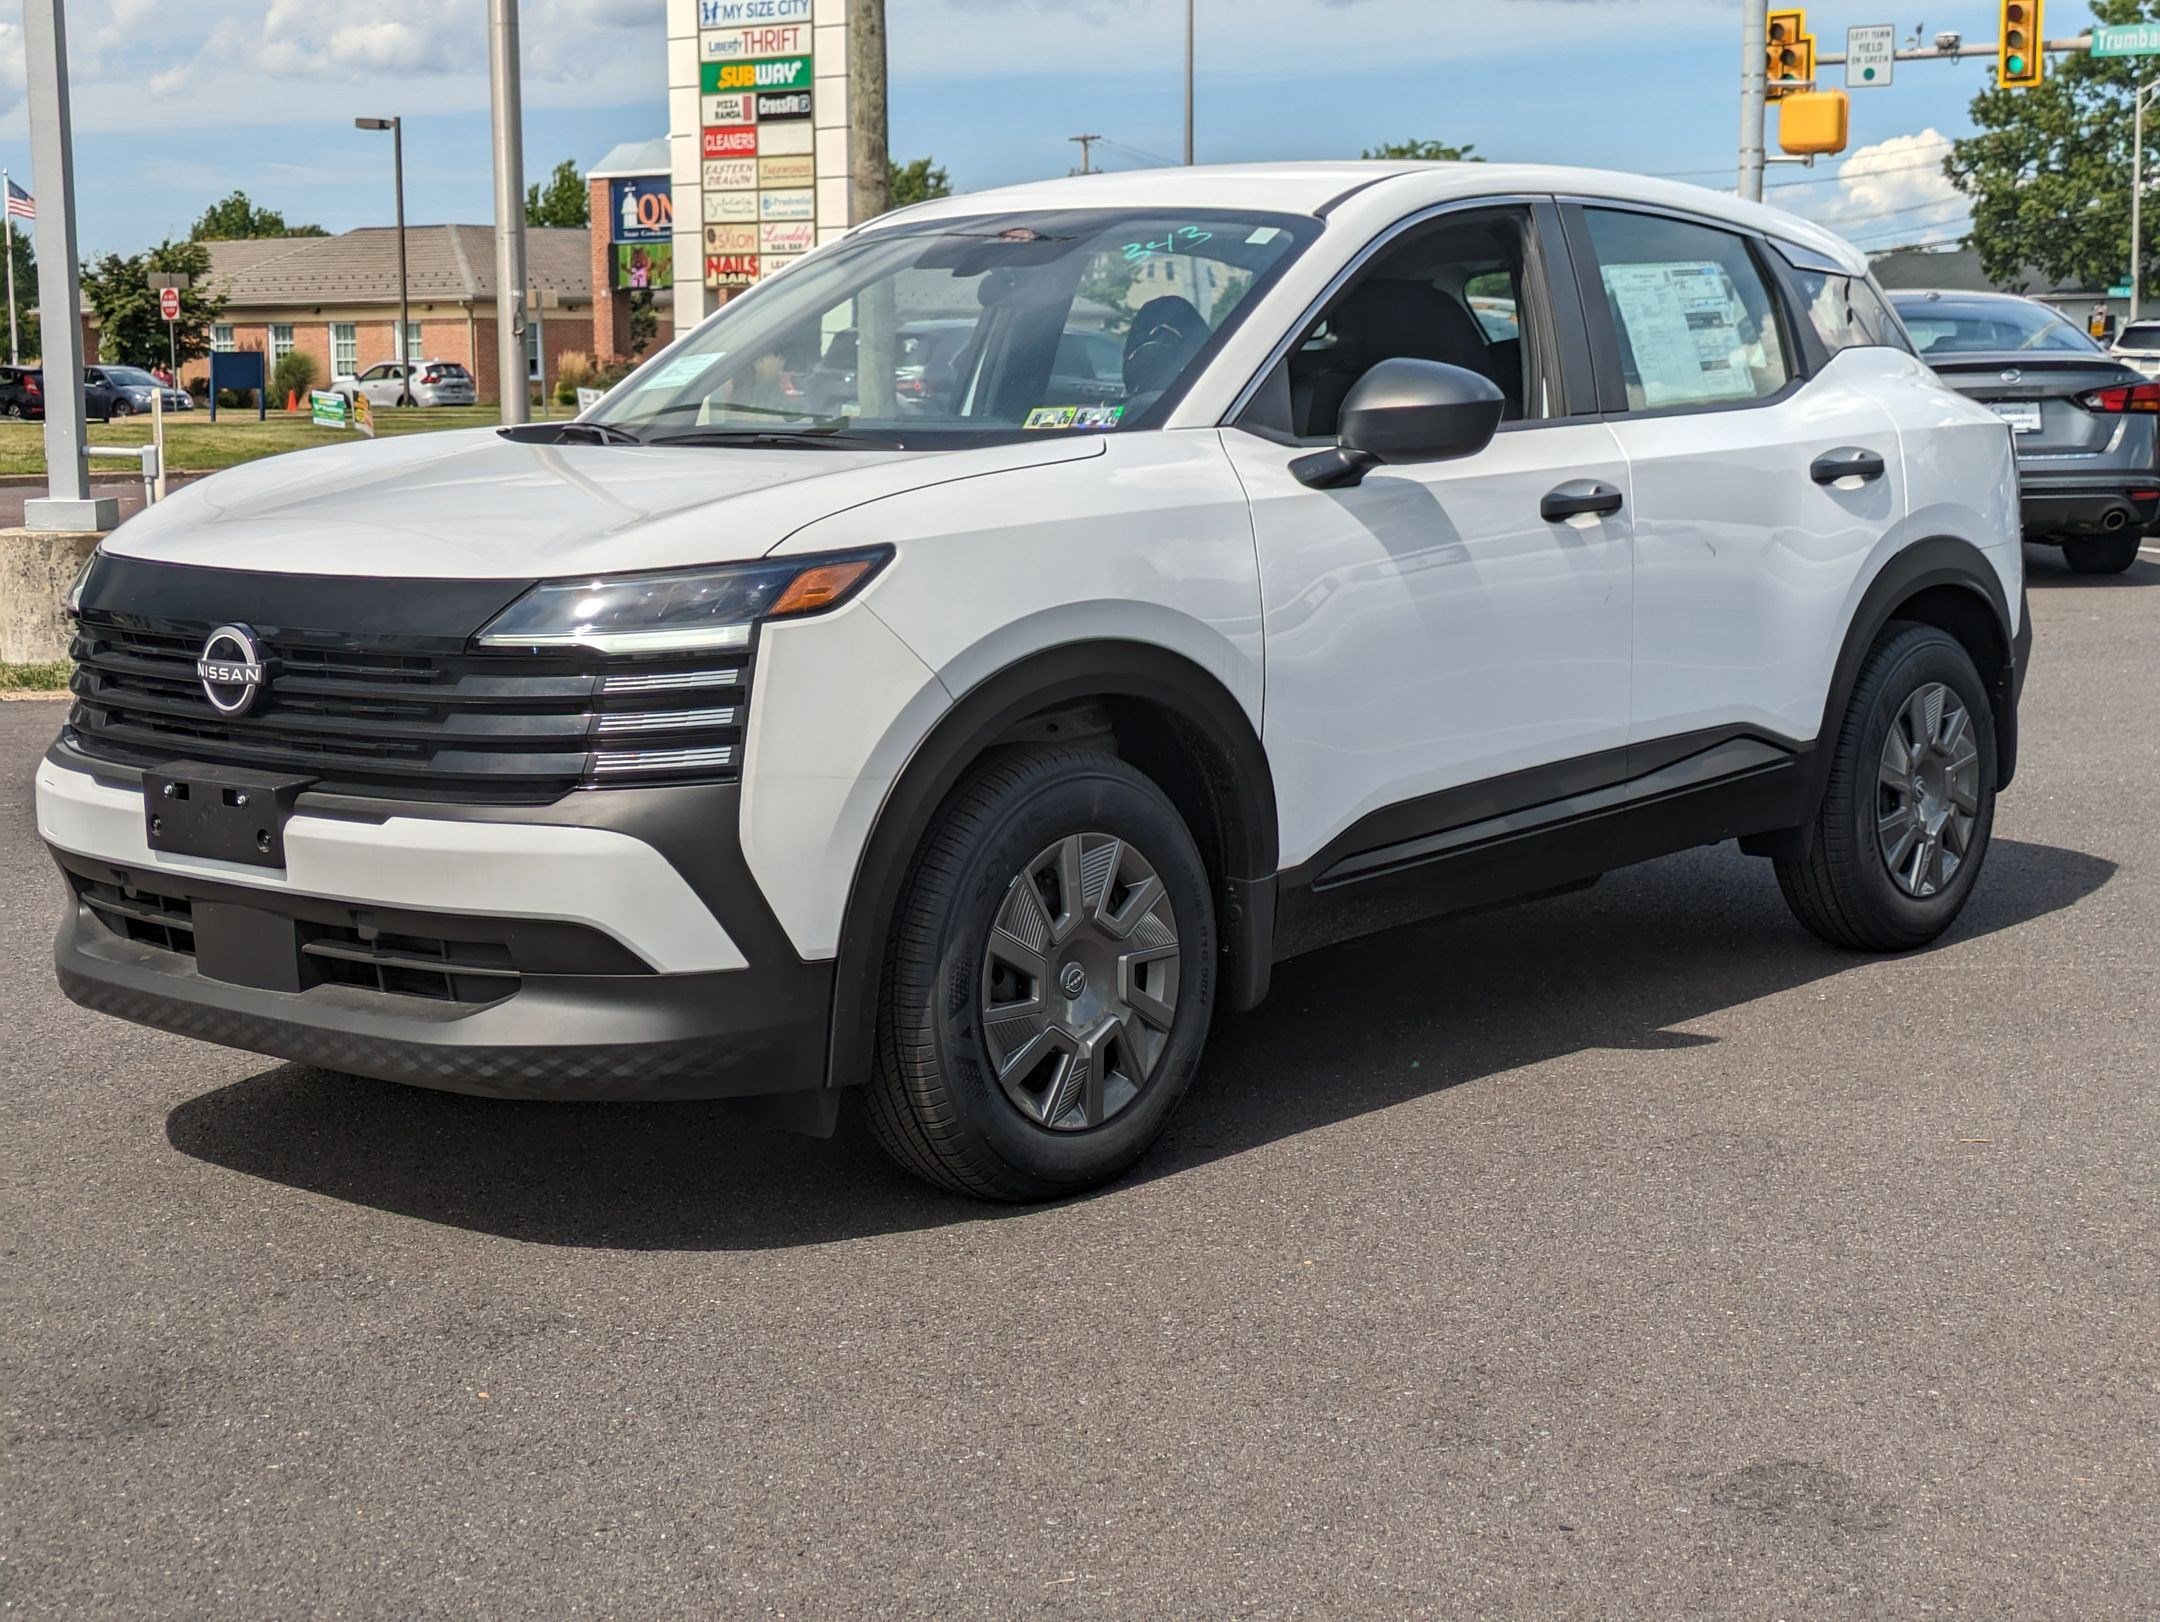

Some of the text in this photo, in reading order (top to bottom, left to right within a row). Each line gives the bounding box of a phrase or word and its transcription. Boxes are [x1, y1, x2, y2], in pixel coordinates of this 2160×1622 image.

[722, 0, 808, 19] MY SIZE CITY
[742, 27, 799, 54] THRIFT
[1851, 31, 1890, 41] LEFT TURN
[1858, 42, 1883, 53] YIELD
[1851, 55, 1888, 64] ON GREEN
[717, 61, 801, 89] SUBWAY
[716, 100, 738, 109] PIZZA
[758, 95, 798, 115] CrossFit
[704, 132, 755, 150] CLEANERS
[705, 164, 753, 175] EASTERN
[706, 255, 757, 279] NAILS
[197, 663, 258, 681] NISSAN
